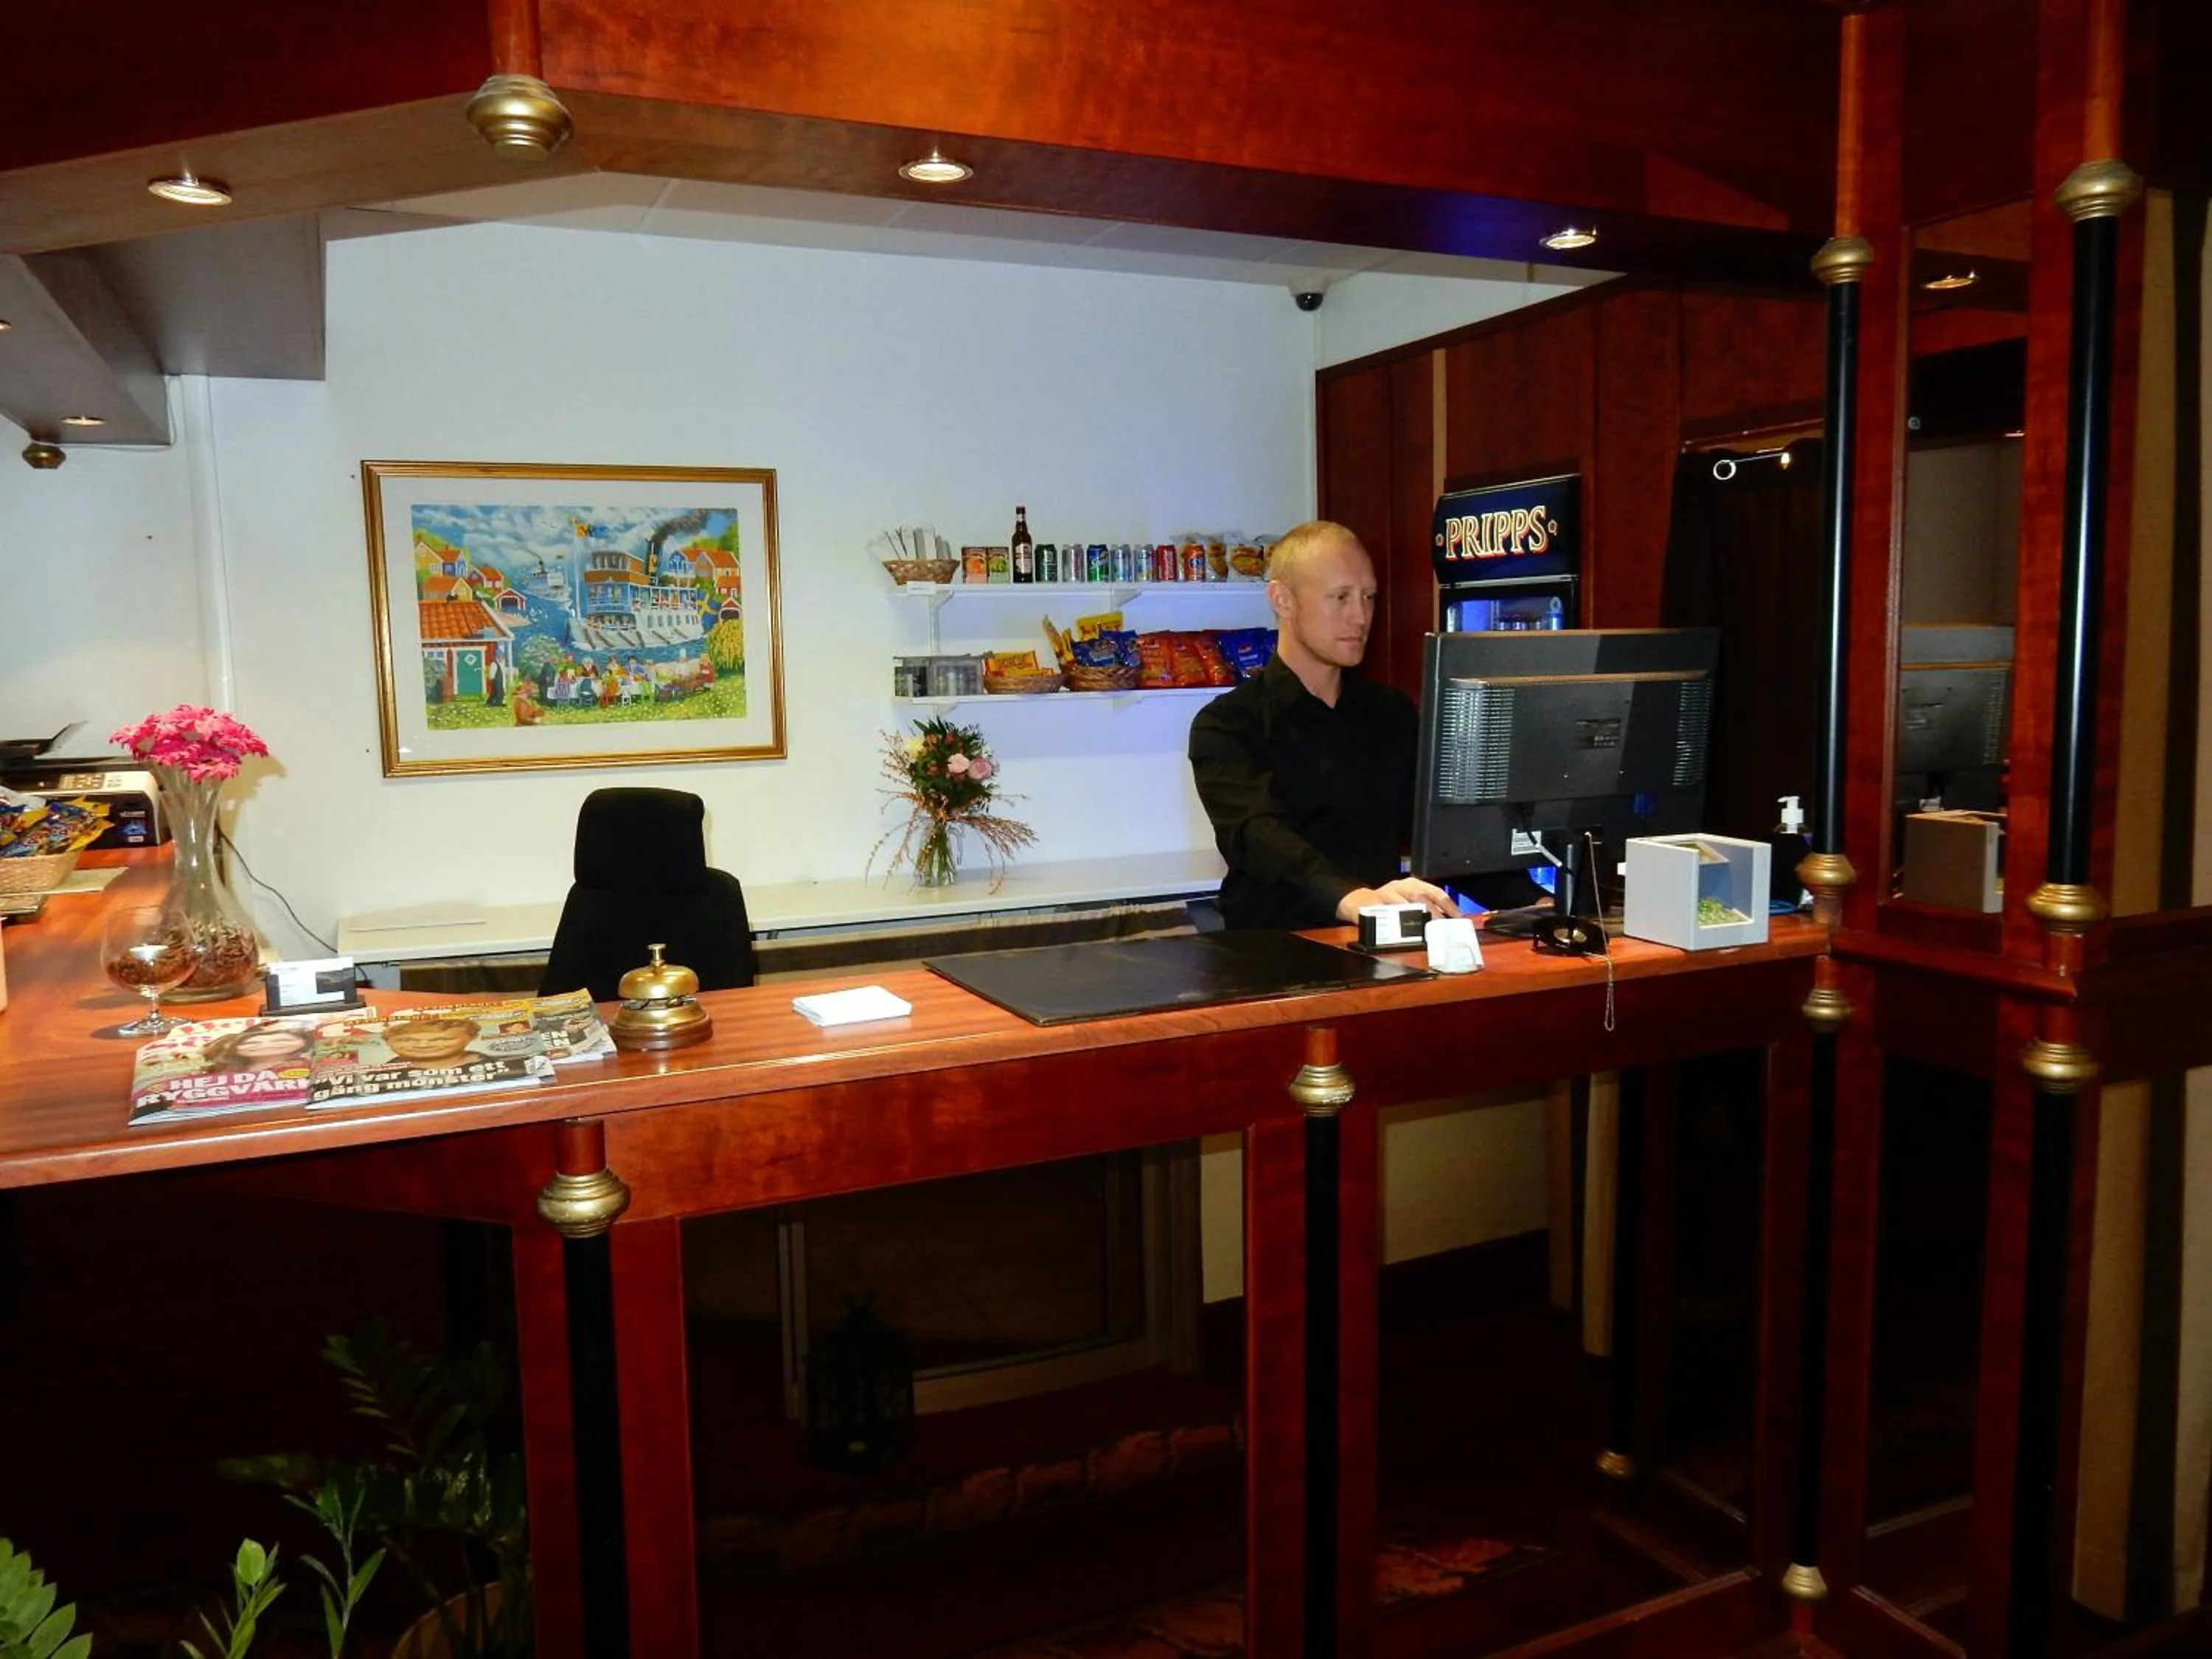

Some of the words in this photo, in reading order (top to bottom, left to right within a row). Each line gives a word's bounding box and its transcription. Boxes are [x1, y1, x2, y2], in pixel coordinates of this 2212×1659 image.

[1445, 505, 1549, 560] PRIPPS
[407, 1067, 462, 1077] som
[170, 1075, 223, 1091] HEJ
